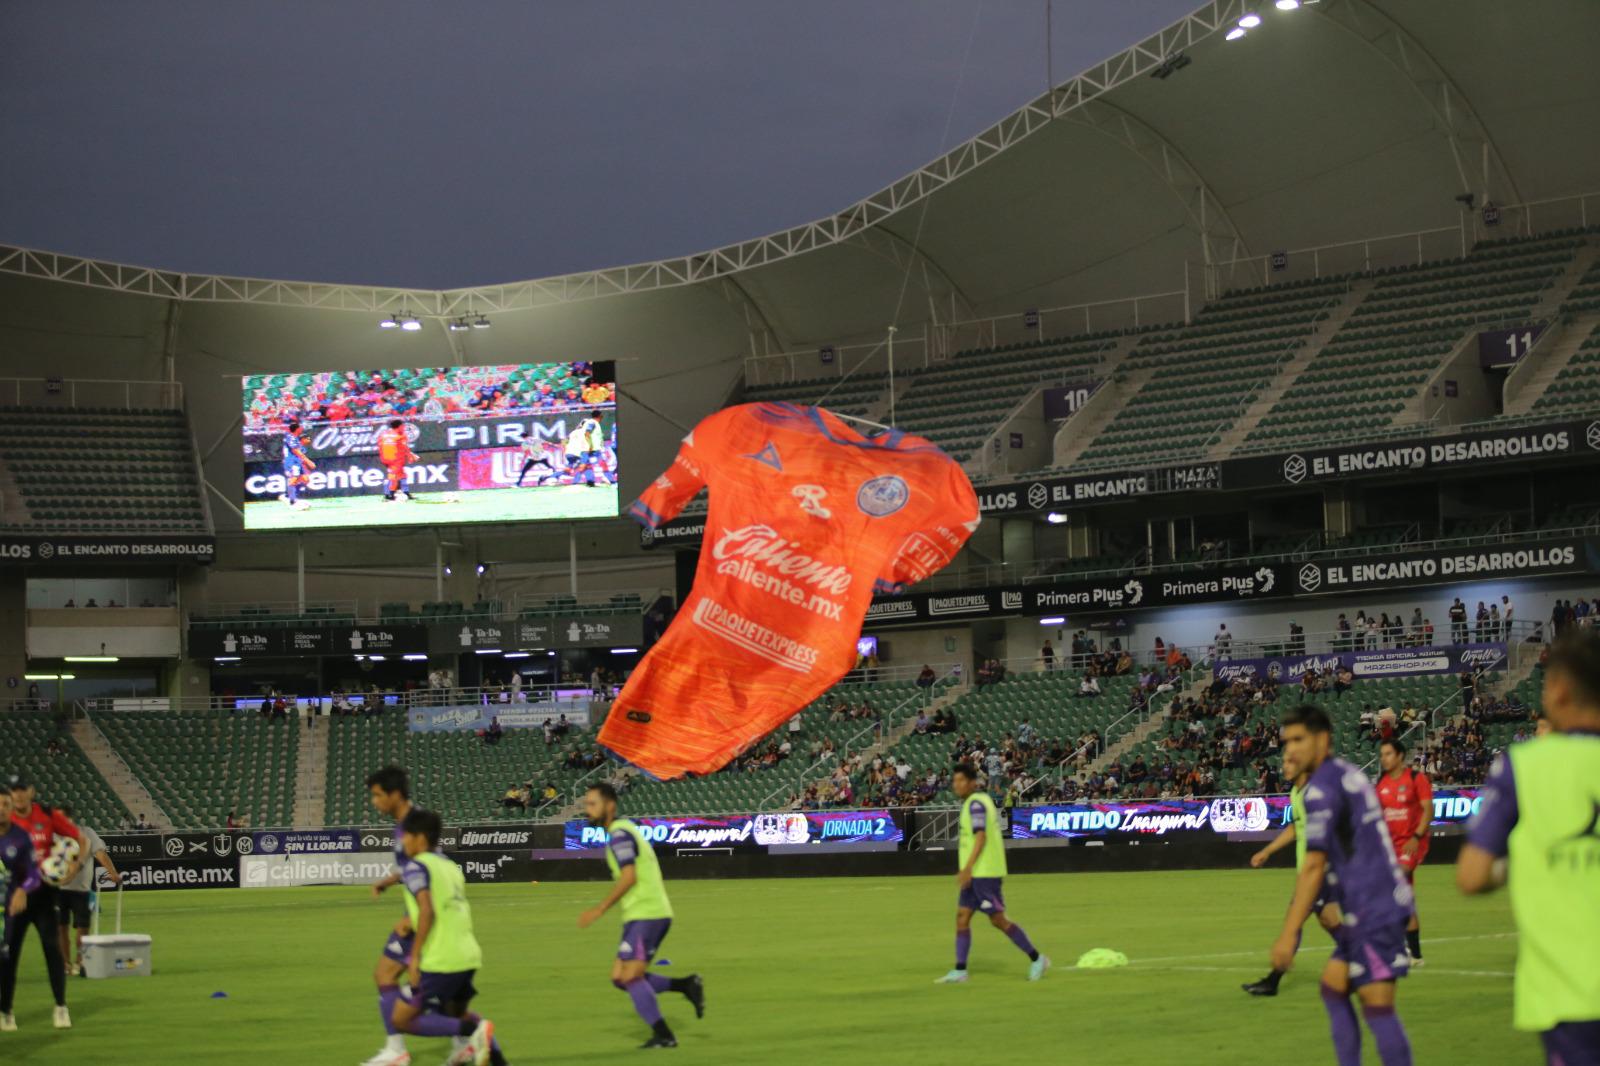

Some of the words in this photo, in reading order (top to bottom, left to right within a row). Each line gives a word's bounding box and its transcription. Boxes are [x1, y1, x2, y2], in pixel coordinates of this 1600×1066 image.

[1506, 332, 1531, 358] 11
[1064, 389, 1088, 412] 10
[1313, 457, 1334, 475] EL
[1339, 447, 1426, 472] ENCANTO
[1431, 431, 1569, 463] DESARROLLOS
[245, 463, 450, 494] caentemx
[1053, 486, 1071, 502] EL
[1075, 477, 1146, 498] ENCANTO
[654, 529, 665, 538] EL
[666, 525, 705, 537] ENCANT
[0, 545, 31, 558] LOS
[58, 546, 71, 555] EL
[75, 545, 128, 555] ENCANTO
[132, 544, 214, 555] DESARROLLOS
[712, 525, 853, 595] Caliente
[1327, 567, 1348, 584] EL
[1352, 560, 1436, 582] ENCANTO
[1442, 547, 1575, 574] DESARROLLOS
[717, 560, 844, 622] caliente.mx
[1037, 592, 1090, 606] Primera
[1093, 588, 1124, 602] Plus
[1163, 579, 1219, 597] Primera
[1222, 577, 1254, 591] Plus
[935, 595, 986, 609] PAQUETEXPRESS
[709, 602, 820, 665] PAQUETEXPRESS
[821, 820, 872, 839] JORNADA
[873, 818, 886, 835] 2
[1031, 811, 1120, 831] PARTIDO
[1118, 805, 1209, 835] Inaugural
[581, 825, 668, 843] PADO
[666, 820, 753, 847] Inaugural
[285, 842, 305, 851] SIN
[307, 841, 353, 851] LLORAR
[119, 866, 234, 886] caliente.mx
[270, 860, 393, 880] caliente.mx
[467, 861, 495, 874] Plus
